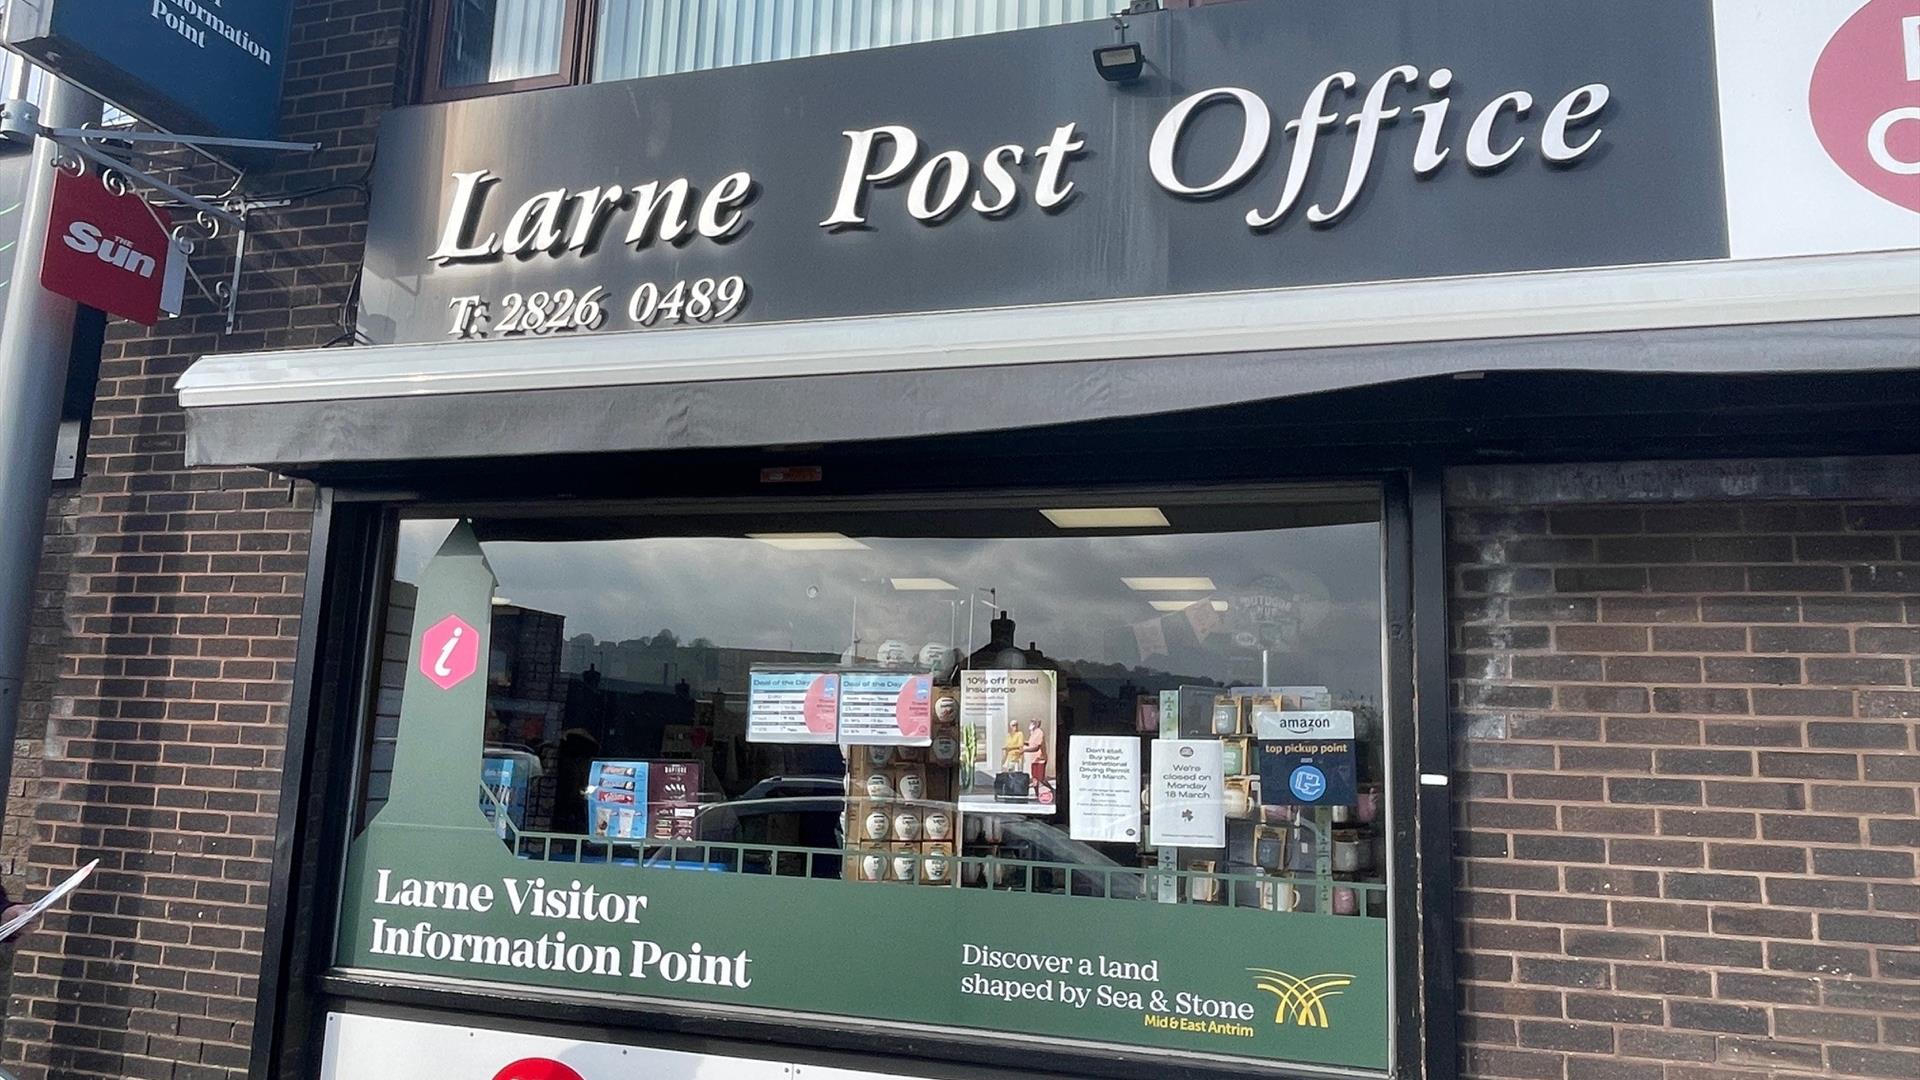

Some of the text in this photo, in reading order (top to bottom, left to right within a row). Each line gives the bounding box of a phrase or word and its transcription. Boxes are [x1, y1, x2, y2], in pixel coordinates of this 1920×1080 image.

[151, 0, 205, 48] Point
[428, 64, 1611, 264] Larne Post Office
[63, 221, 156, 278] Sun
[495, 285, 603, 333] 2826
[629, 274, 745, 324] 0489
[967, 676, 1039, 685] 10% off travel
[1280, 718, 1330, 728] amazon
[1265, 743, 1348, 755] top pickup point
[1163, 773, 1196, 781] closed
[1172, 764, 1202, 772] We're
[1165, 790, 1210, 799] 18 March
[1166, 782, 1207, 792] Monday
[374, 869, 648, 924] Larne Visitor
[369, 917, 753, 990] Information Point
[961, 943, 1160, 982] Discover a land
[961, 973, 1255, 1021] shaped by Sea & Stone
[1144, 1014, 1168, 1028] Mid
[1180, 1018, 1207, 1033] East
[1208, 1020, 1254, 1037] Antrim
